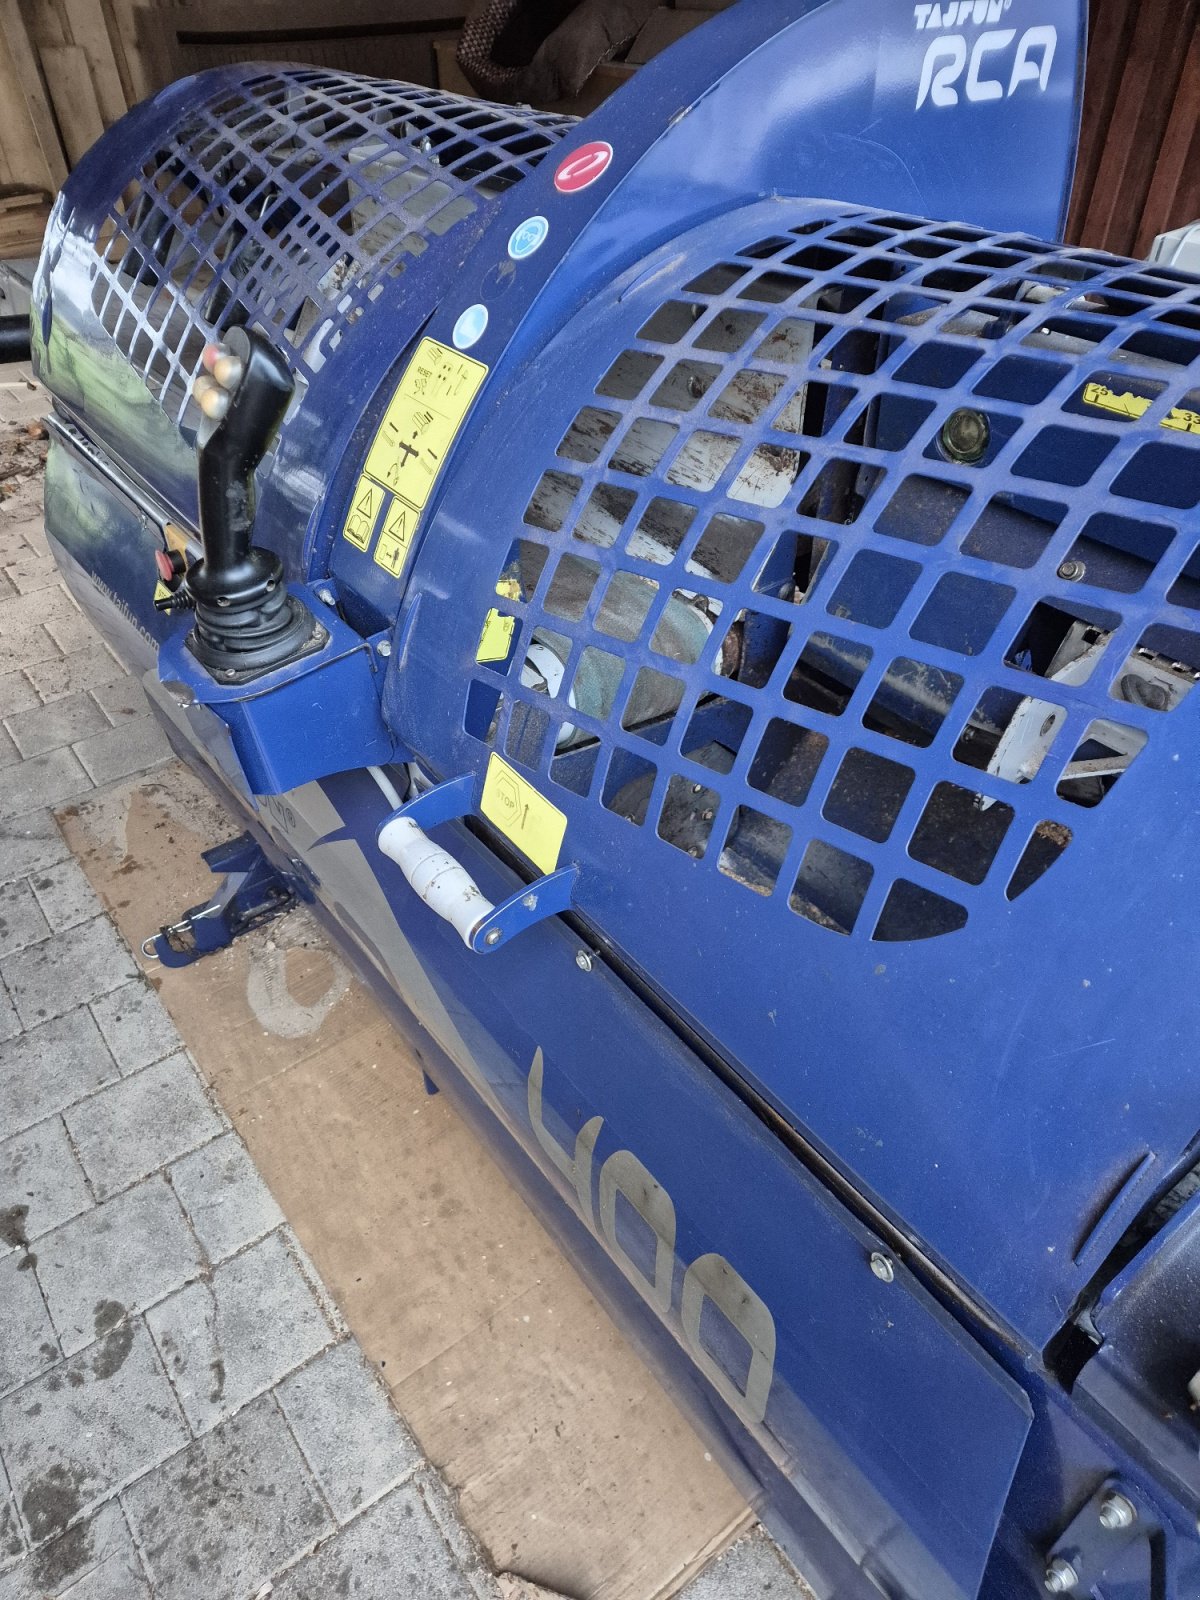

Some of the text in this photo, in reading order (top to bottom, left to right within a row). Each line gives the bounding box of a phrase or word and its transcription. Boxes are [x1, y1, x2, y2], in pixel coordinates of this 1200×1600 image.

[915, 25, 1058, 111] RCA
[417, 366, 433, 378] RESET
[1091, 384, 1109, 396] 25
[496, 787, 515, 809] STOP
